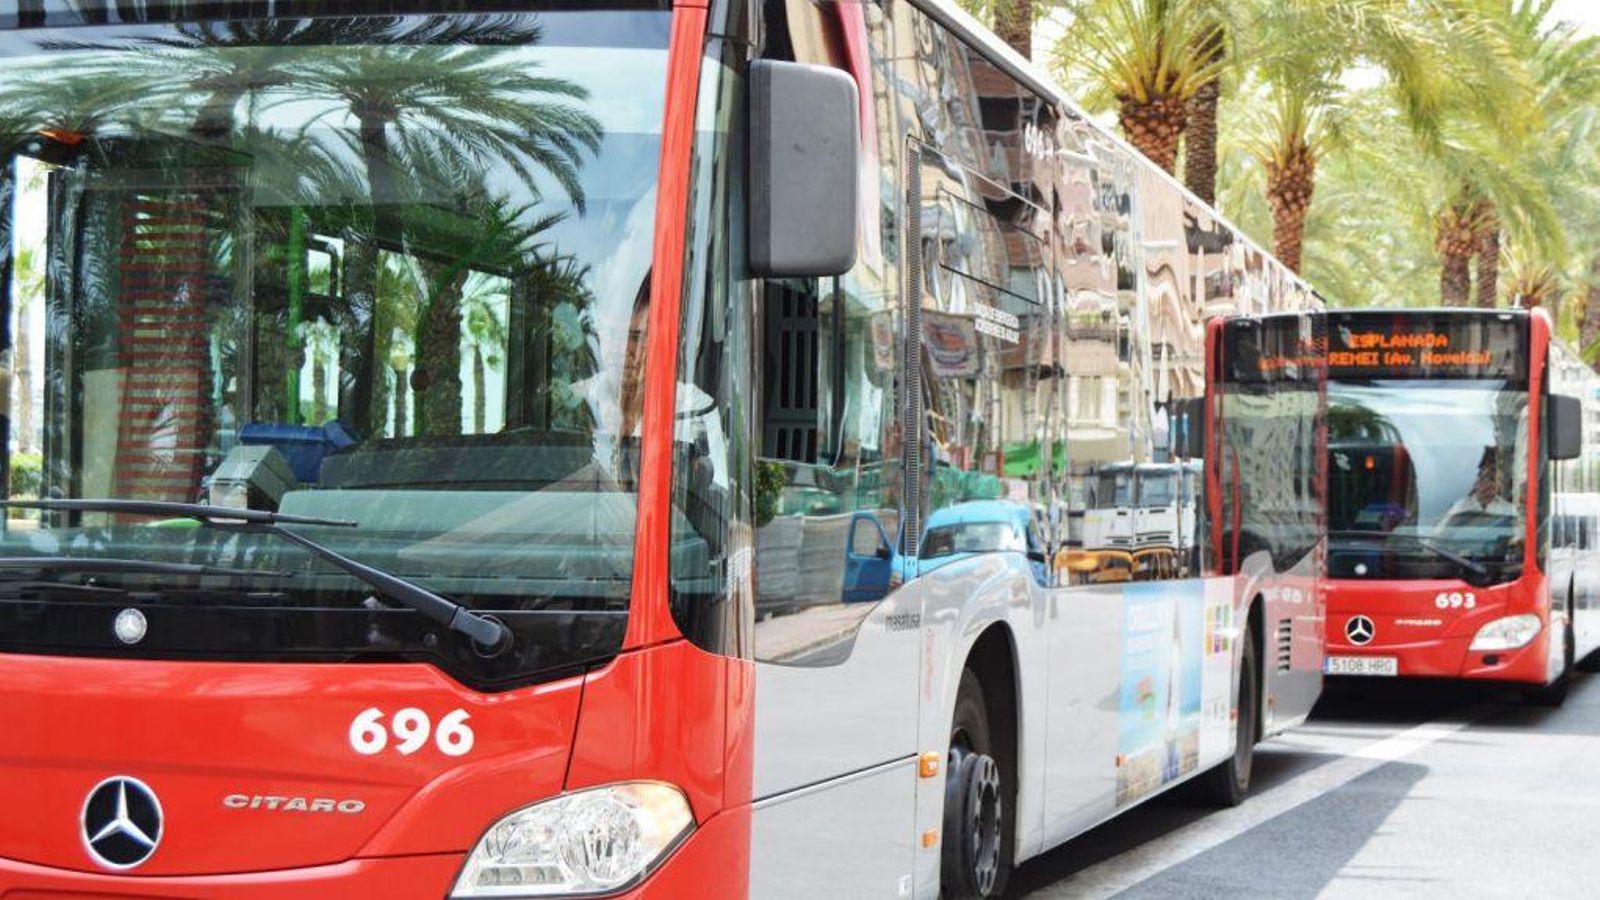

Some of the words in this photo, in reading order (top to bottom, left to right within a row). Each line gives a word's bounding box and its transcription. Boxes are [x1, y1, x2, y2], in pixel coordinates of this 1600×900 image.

[1350, 333, 1447, 348] ESPLANADA
[1329, 351, 1379, 365] REMEI
[1435, 592, 1476, 609] 693
[1332, 658, 1363, 672] 5108
[349, 706, 475, 756] 696
[223, 793, 366, 813] CITARO
